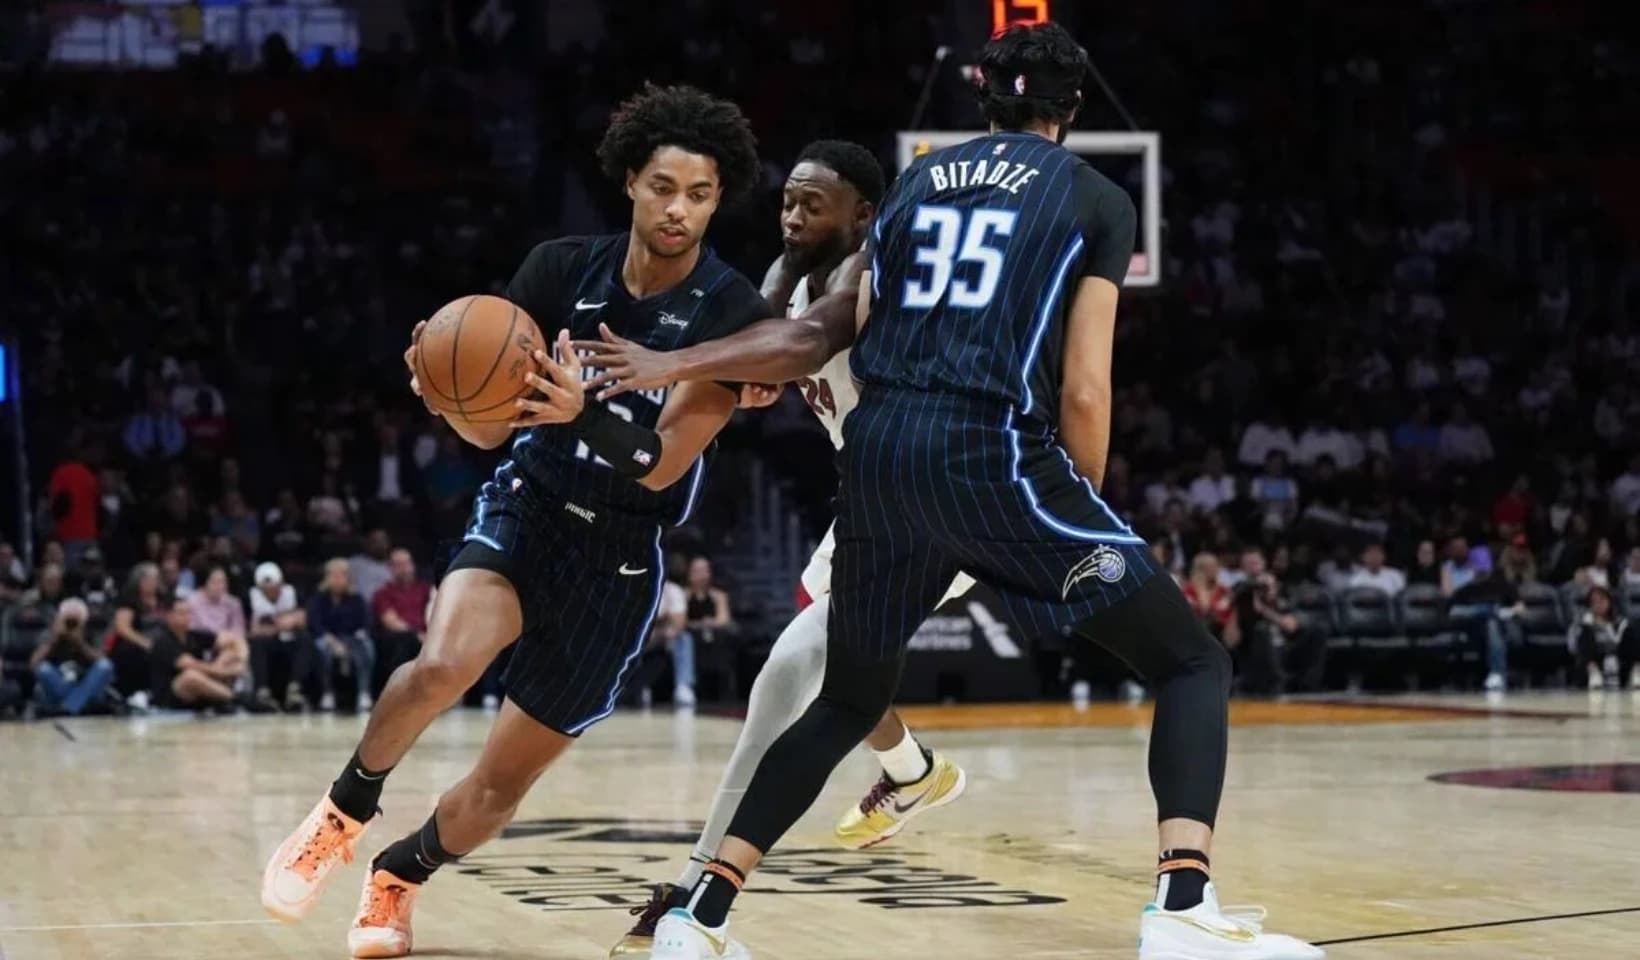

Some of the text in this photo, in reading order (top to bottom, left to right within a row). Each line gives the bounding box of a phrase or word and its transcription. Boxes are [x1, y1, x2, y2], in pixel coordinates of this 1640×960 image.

[929, 159, 1040, 195] BITADZE
[901, 203, 1019, 309] 35
[657, 310, 689, 331] Disney
[798, 376, 837, 420] 24
